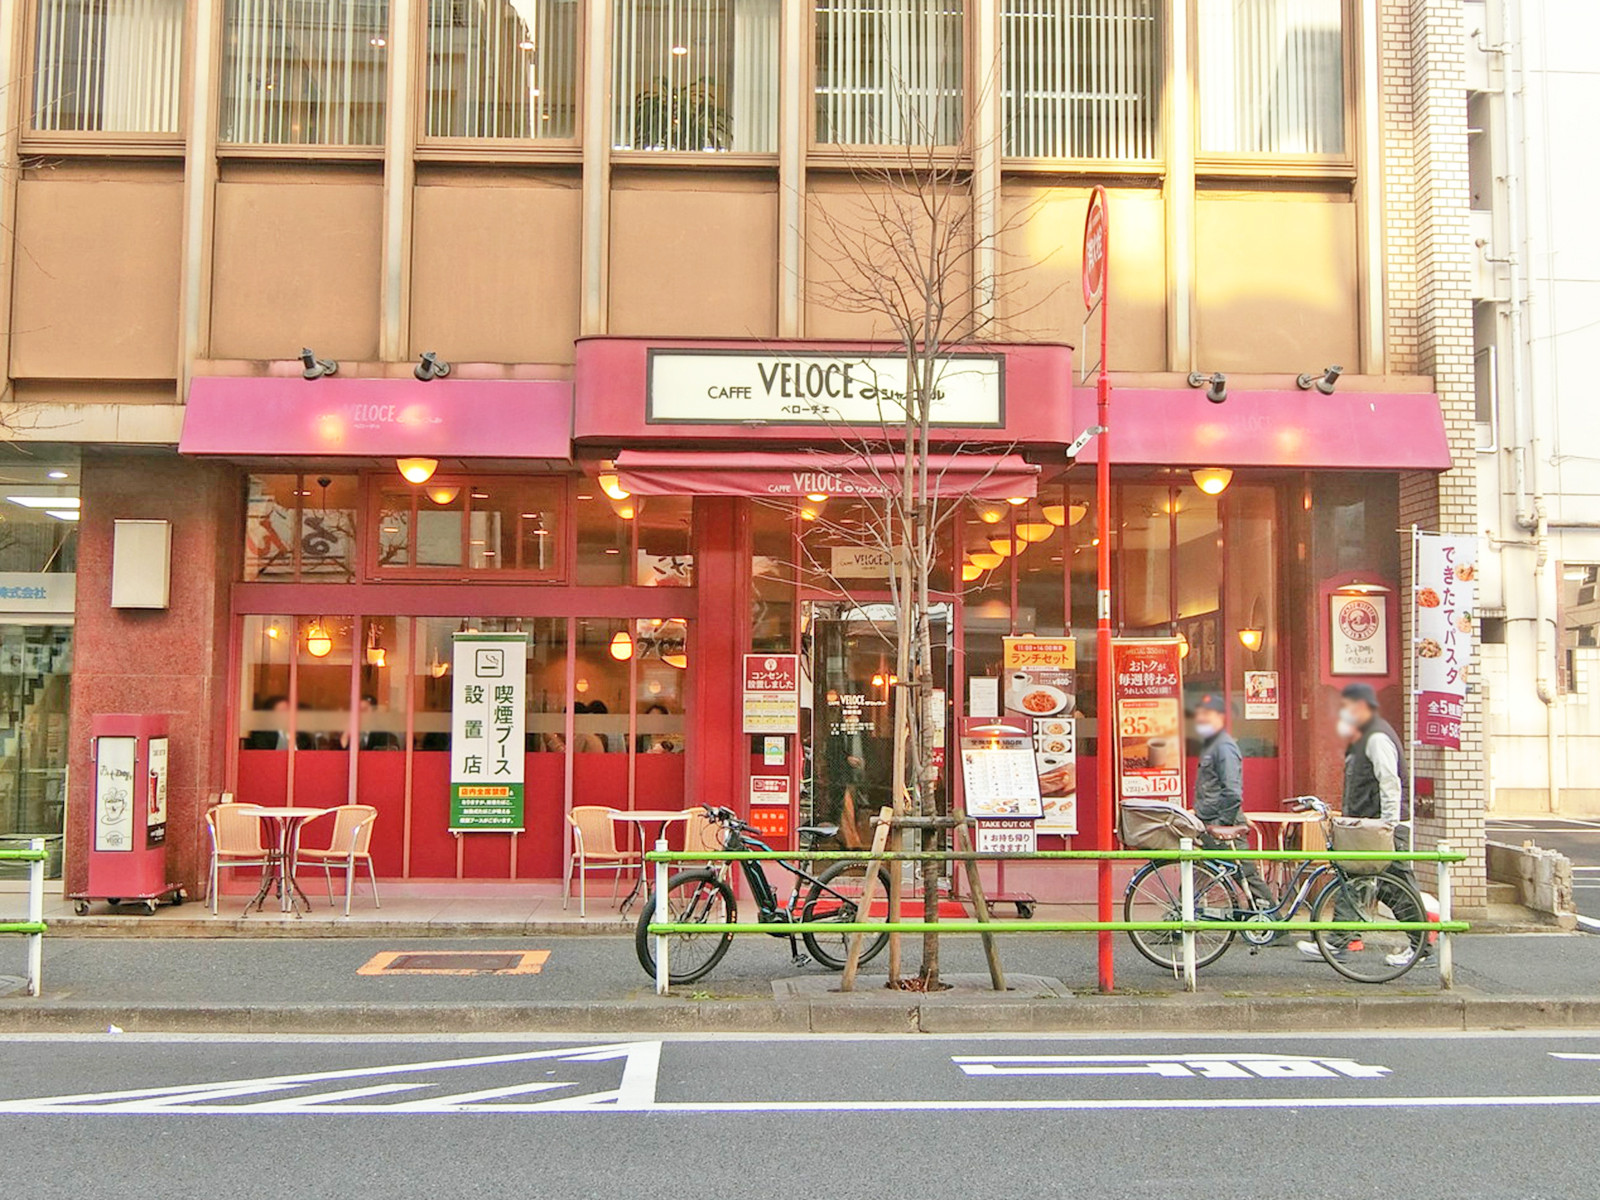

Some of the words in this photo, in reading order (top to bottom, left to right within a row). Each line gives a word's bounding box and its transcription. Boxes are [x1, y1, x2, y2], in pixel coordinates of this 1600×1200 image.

[707, 386, 752, 399] CAFFE
[757, 362, 853, 398] VELOCE
[781, 405, 830, 414] ベローチェ
[767, 484, 792, 493] CAFFE
[793, 472, 843, 492] VELOCE
[1441, 546, 1459, 686] できたてパスタ
[1011, 653, 1070, 665] ランチセット
[1128, 660, 1167, 672] おトクが
[751, 671, 790, 680] コンセント
[1119, 672, 1177, 686] 毎週替わる
[463, 685, 485, 775] 設置店
[494, 685, 515, 776] 喫煙ブース
[991, 834, 1030, 842] お持ち帰り
